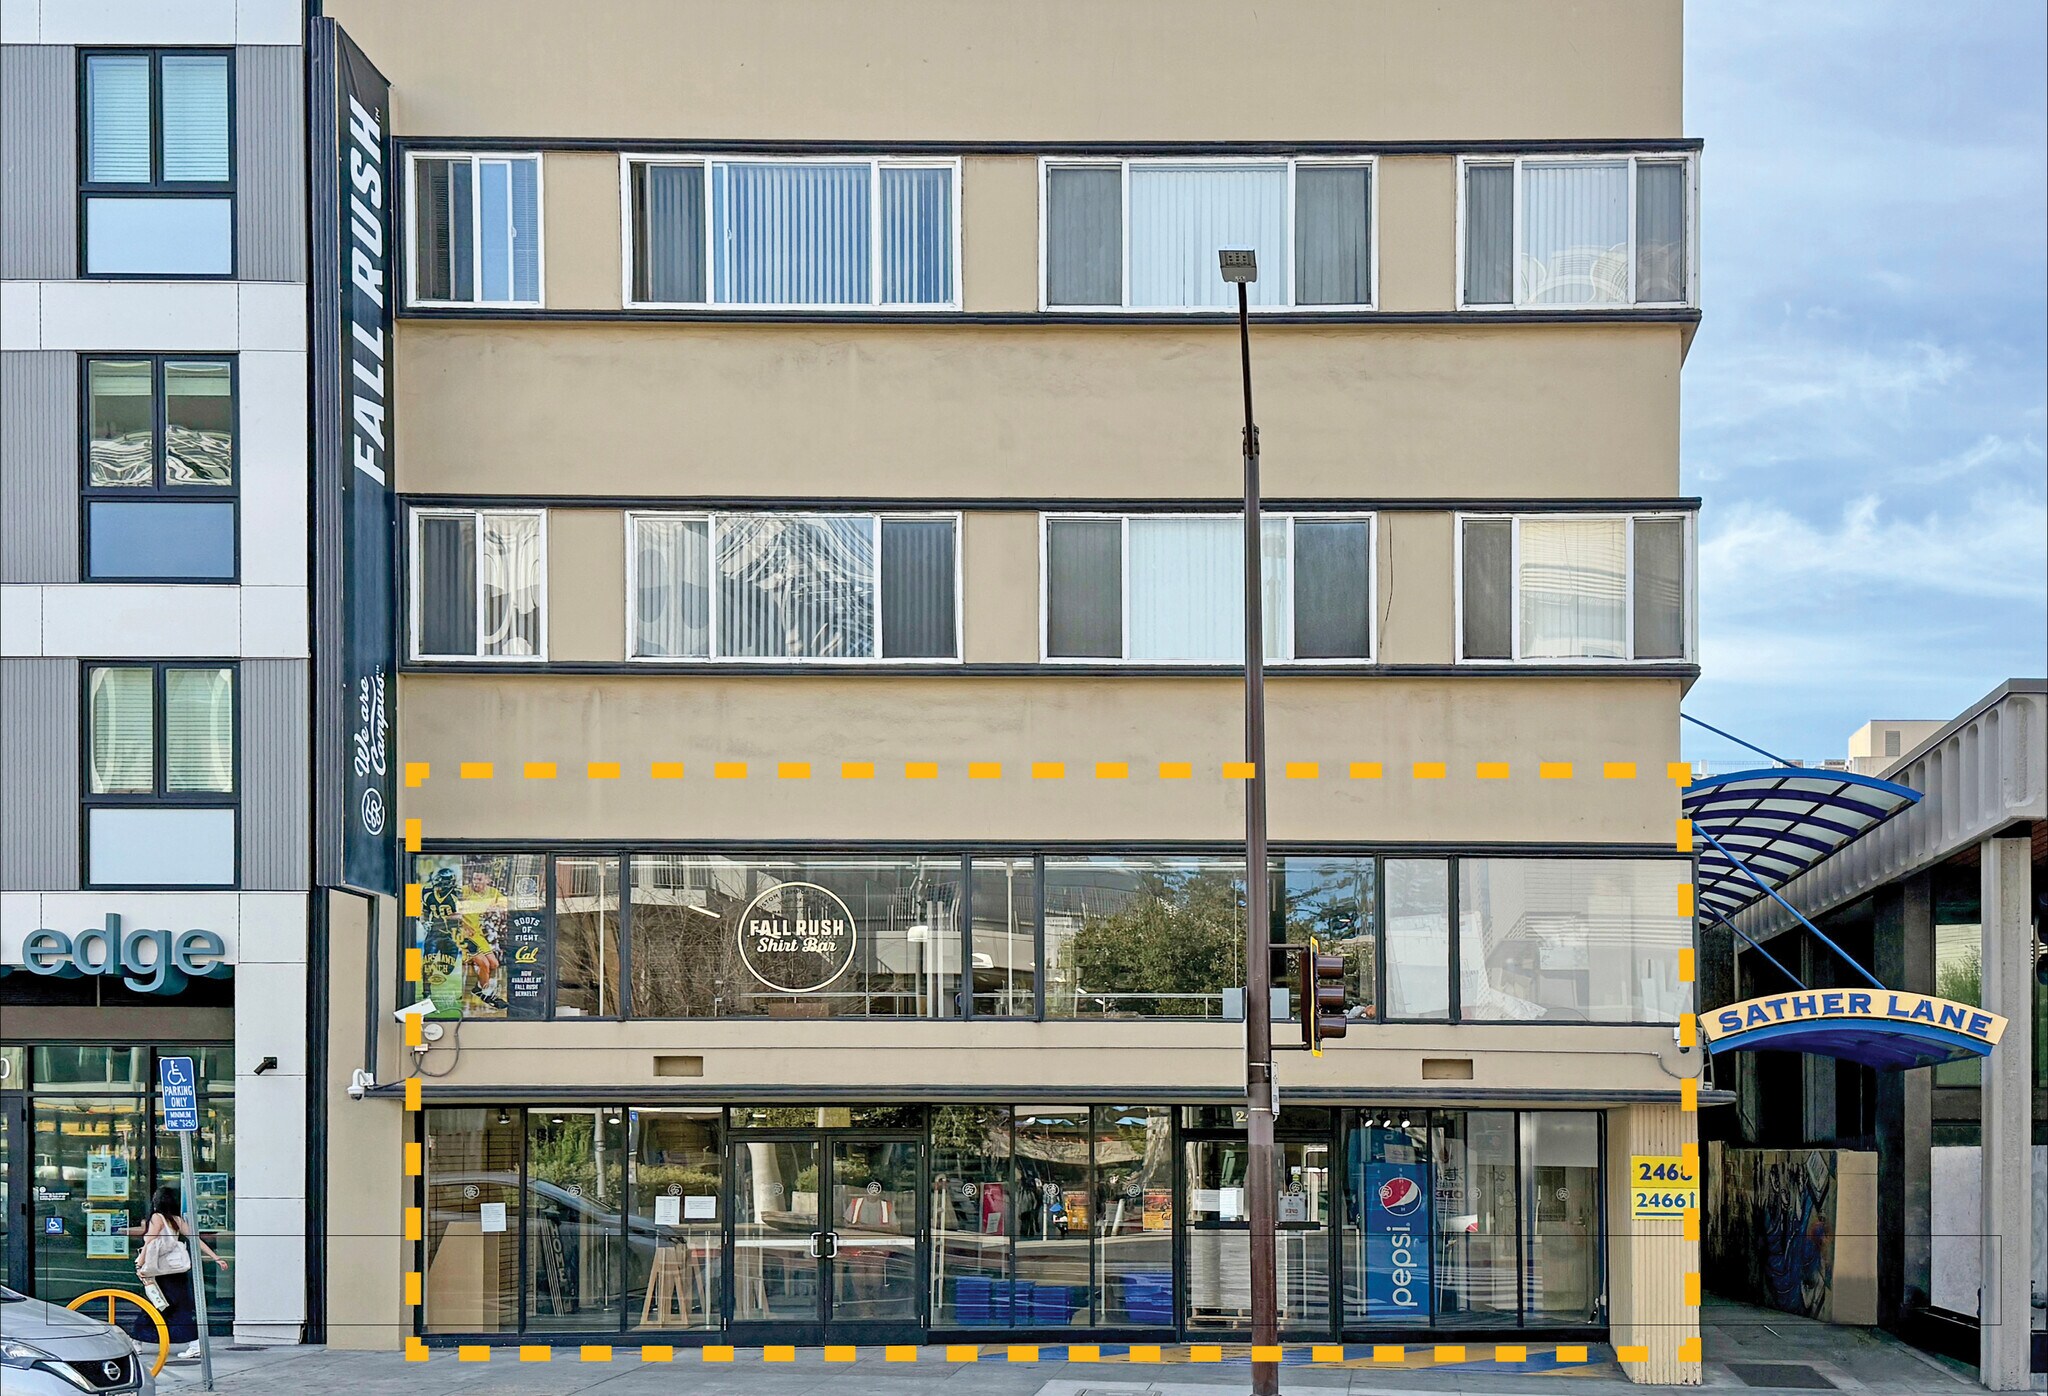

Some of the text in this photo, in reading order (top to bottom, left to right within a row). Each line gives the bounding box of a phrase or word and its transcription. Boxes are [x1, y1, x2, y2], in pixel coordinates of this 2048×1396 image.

[349, 94, 383, 309] RUSH
[352, 319, 386, 487] FALL
[354, 675, 371, 778] We are
[513, 916, 541, 927] ROOTS
[521, 926, 533, 934] OF
[749, 919, 844, 937] FALL RUSH
[514, 934, 539, 942] FIGHT
[756, 937, 838, 953] Shirt Bar
[22, 912, 226, 993] edge
[514, 945, 539, 964] Cal
[1718, 992, 1994, 1038] SATHER LANE
[165, 1085, 193, 1096] PARKING
[171, 1096, 188, 1108] ONLY
[167, 1119, 179, 1128] FINE
[1636, 1192, 1687, 1208] 2466
[550, 1223, 568, 1282] HOME
[1386, 1227, 1418, 1307] pepsi
